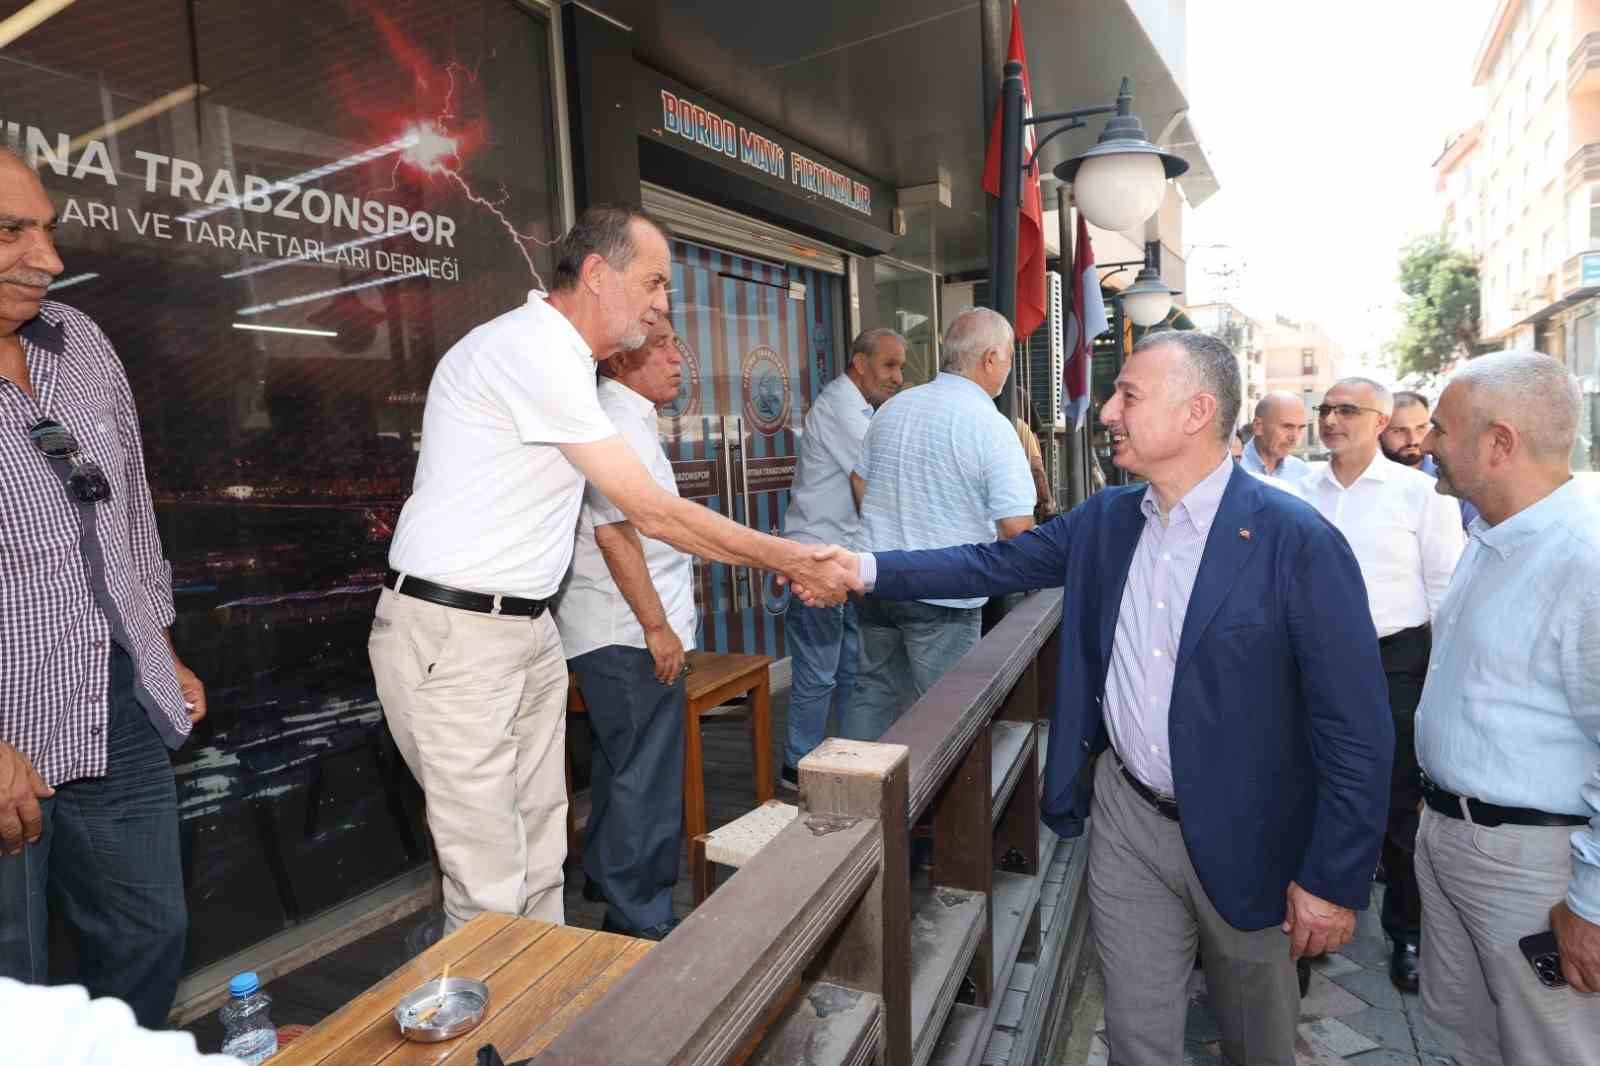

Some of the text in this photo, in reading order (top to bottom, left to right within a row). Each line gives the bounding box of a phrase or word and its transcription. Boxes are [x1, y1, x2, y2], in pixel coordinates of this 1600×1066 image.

[0, 119, 457, 247] INA TRABZONSPOR
[661, 89, 737, 159] BORDO
[790, 152, 872, 217] FIRTINALAR
[61, 198, 460, 282] ARI VE TARAFTARLARI DERNEĞİ
